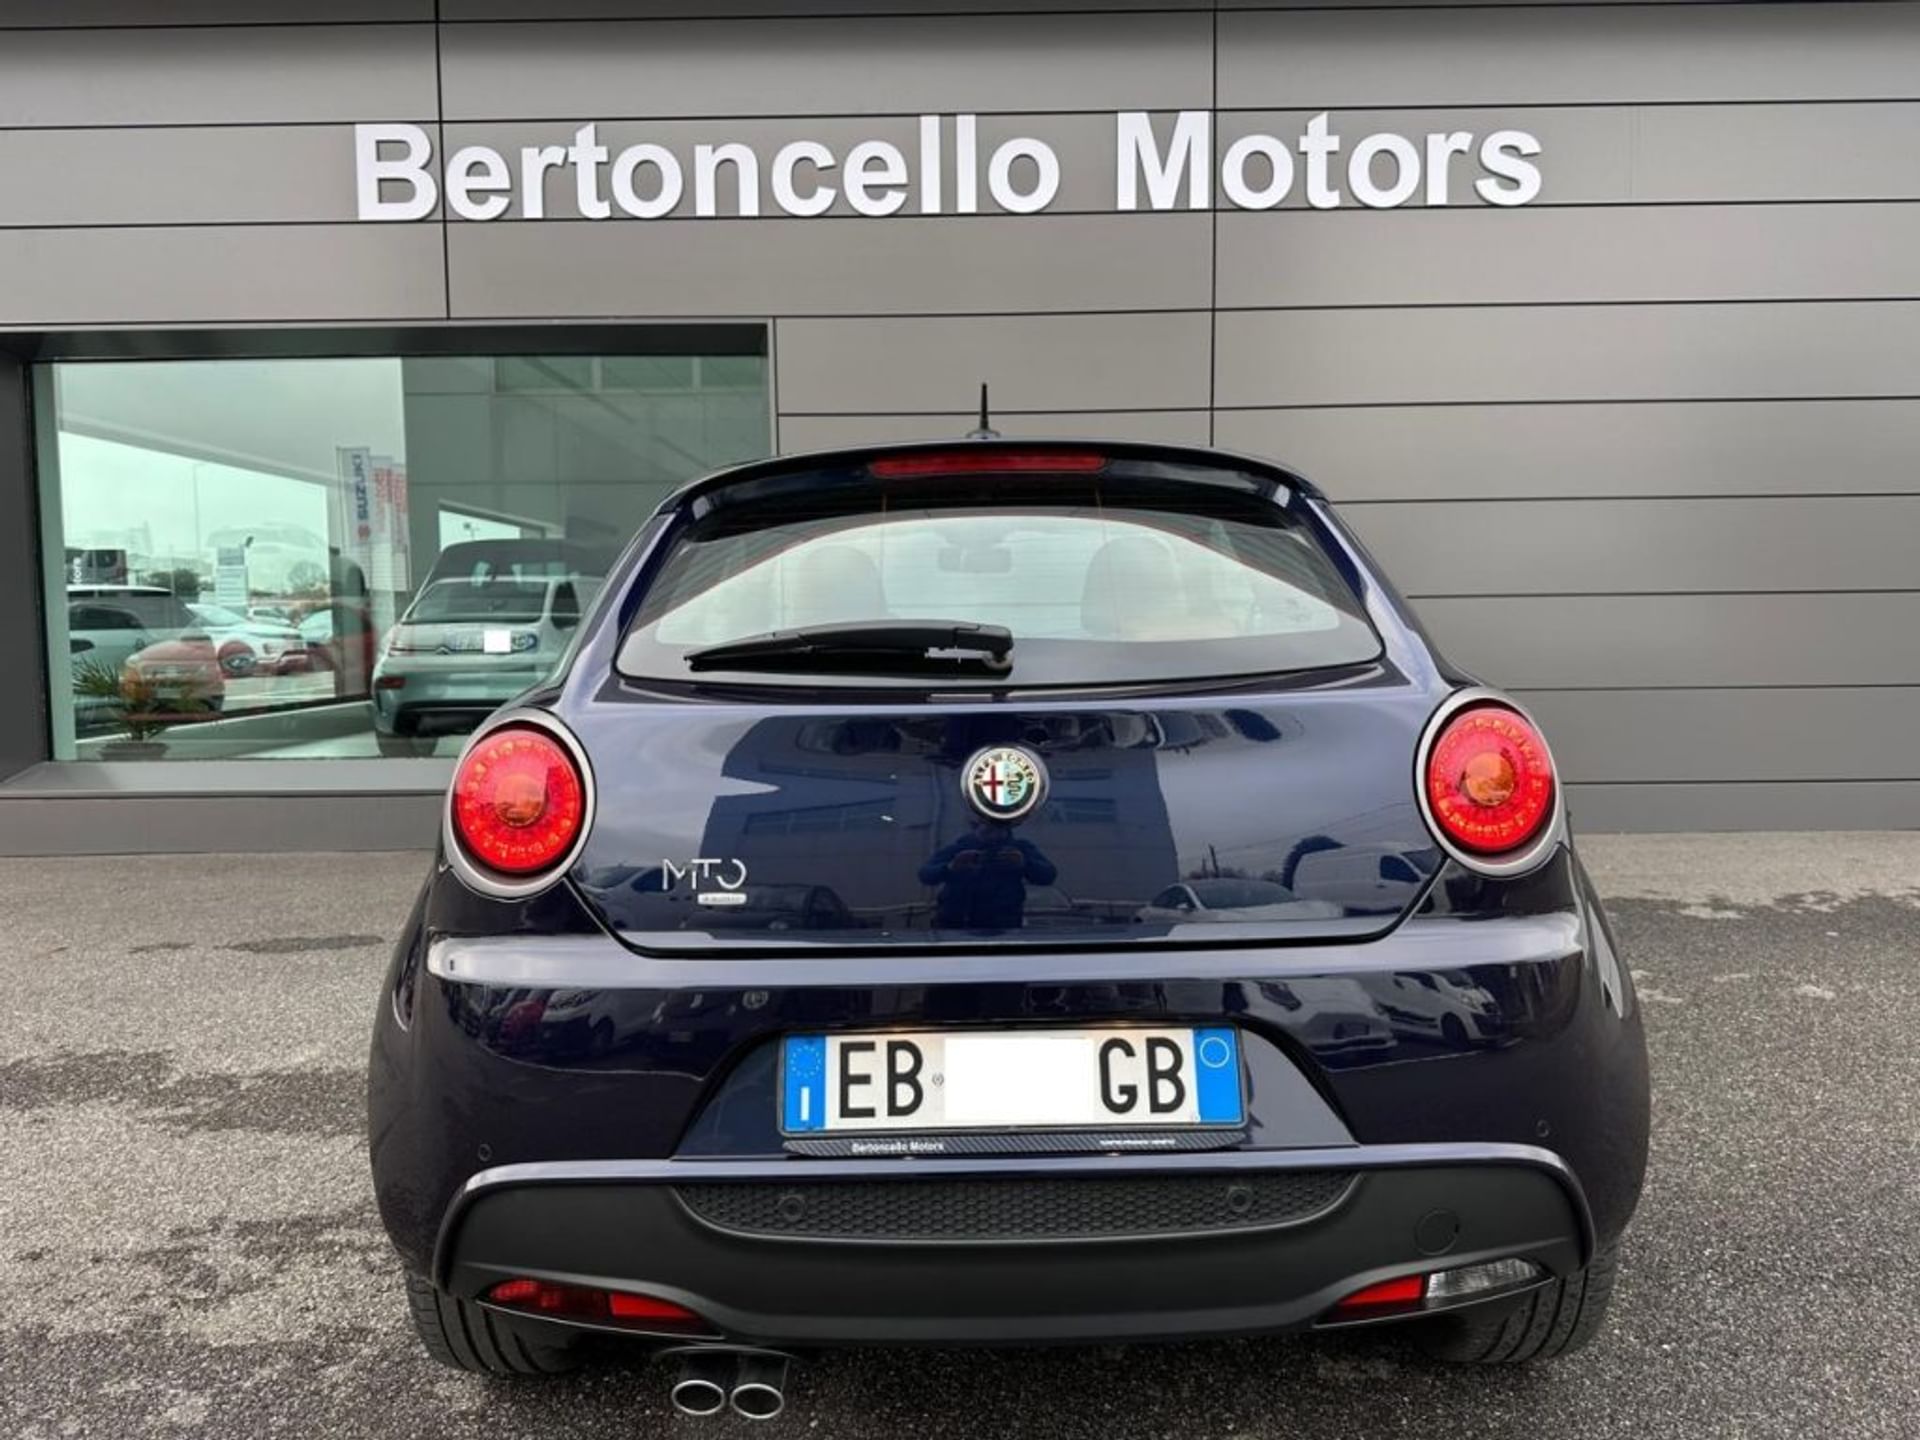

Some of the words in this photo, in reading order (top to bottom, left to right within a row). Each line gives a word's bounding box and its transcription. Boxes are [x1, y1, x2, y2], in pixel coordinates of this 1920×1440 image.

[354, 114, 1060, 223] Bertoncello
[1116, 110, 1543, 212] Motors
[352, 454, 369, 520] SUZUKI
[839, 1040, 923, 1119] EB
[1098, 1037, 1187, 1115] GB
